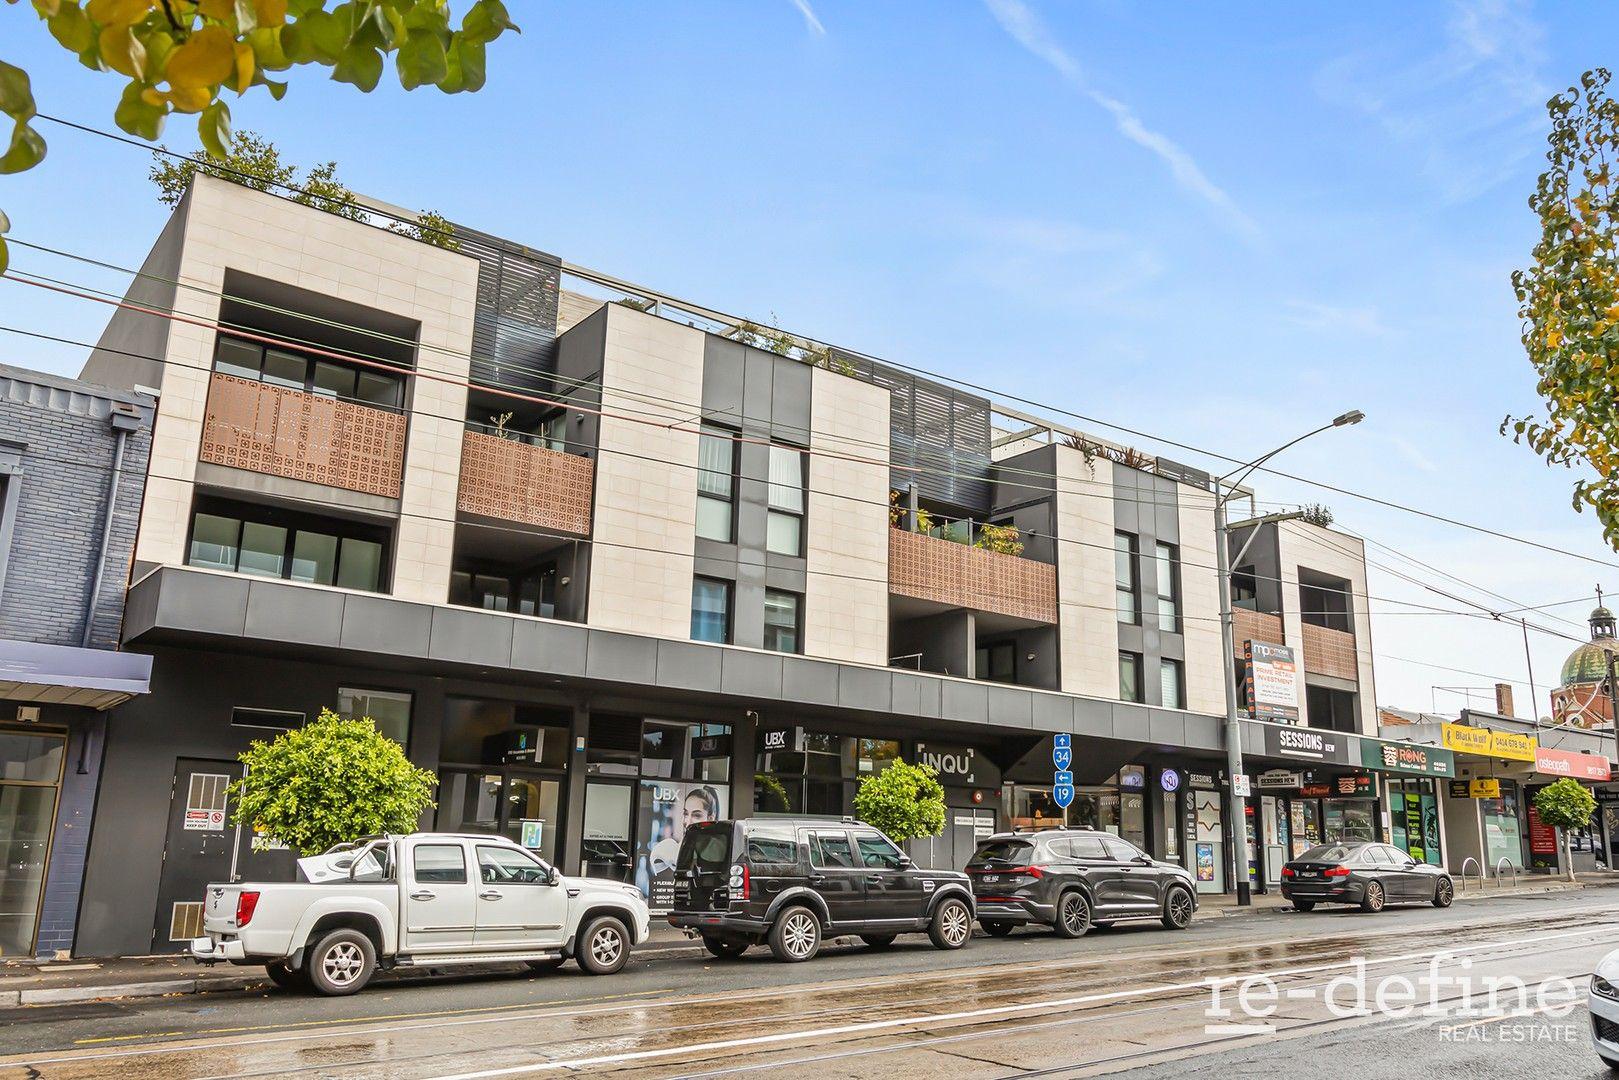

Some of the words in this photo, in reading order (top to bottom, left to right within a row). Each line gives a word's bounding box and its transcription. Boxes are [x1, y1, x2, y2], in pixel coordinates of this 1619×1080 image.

[1257, 674, 1293, 686] INVESTMENT
[765, 731, 785, 746] UBX
[1279, 730, 1322, 750] SESSIONS
[1325, 743, 1335, 752] KEW
[1455, 731, 1471, 742] Black
[1473, 734, 1487, 744] Wolf
[923, 752, 969, 774] INQU
[1056, 751, 1069, 763] 34
[1399, 749, 1427, 763] RONG
[1539, 757, 1571, 774] osteopath
[1189, 774, 1212, 784] SESSIONS
[653, 787, 680, 801] UBX
[1058, 788, 1069, 800] 19
